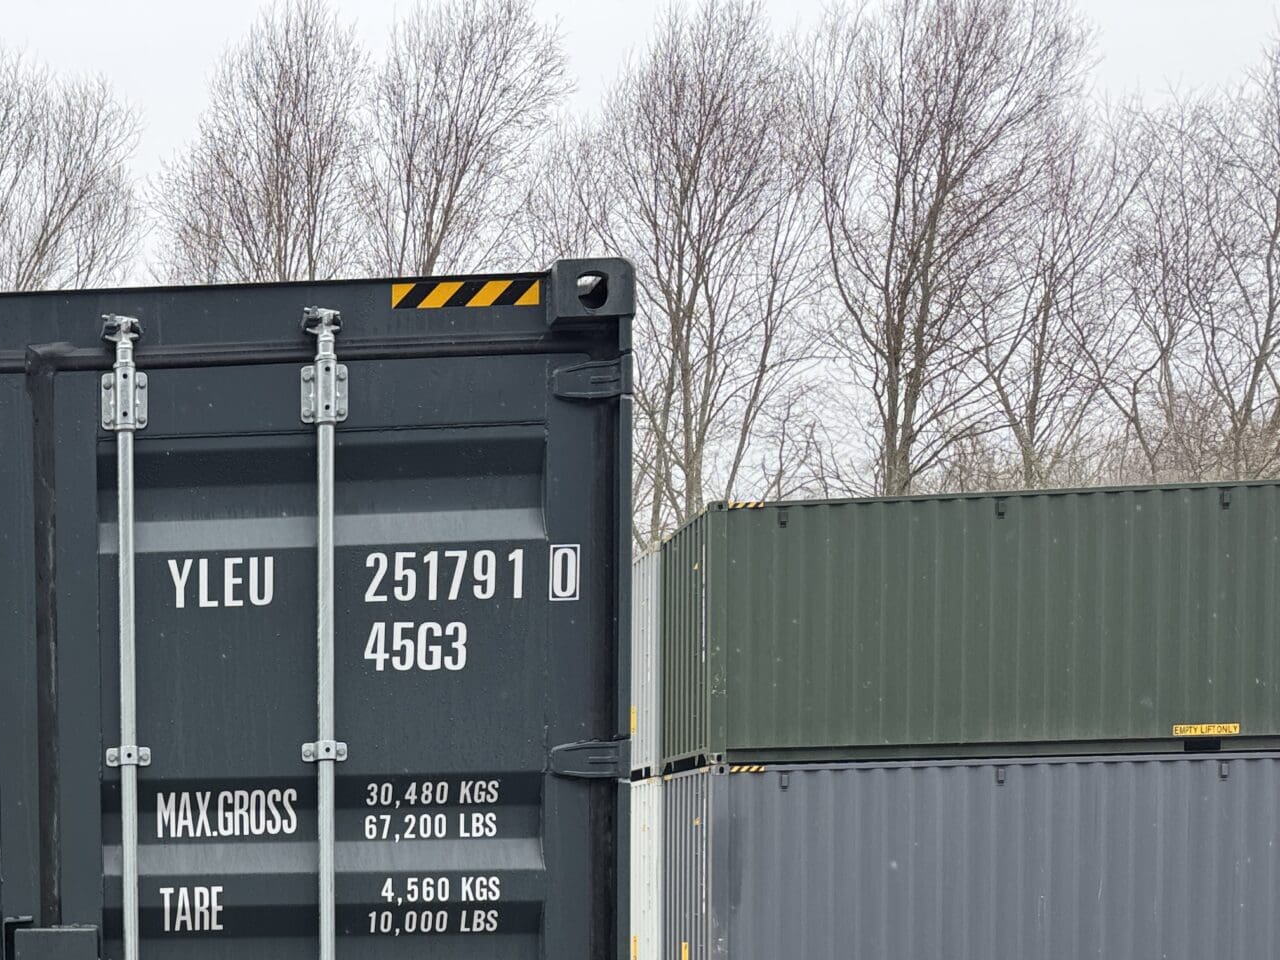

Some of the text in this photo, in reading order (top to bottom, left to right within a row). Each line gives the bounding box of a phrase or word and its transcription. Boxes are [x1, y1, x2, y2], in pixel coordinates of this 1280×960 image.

[168, 548, 577, 608] YLEU 251791 0
[364, 622, 467, 671] 45G3
[1174, 725, 1238, 735] EMPTY LIFT ONLY
[157, 781, 499, 838] MAX.GROSS 30,480 KGS
[364, 813, 497, 842] 67,200 LBS
[160, 876, 500, 931] TARE 4,560 KGS
[369, 910, 498, 935] 10,000 LBS
